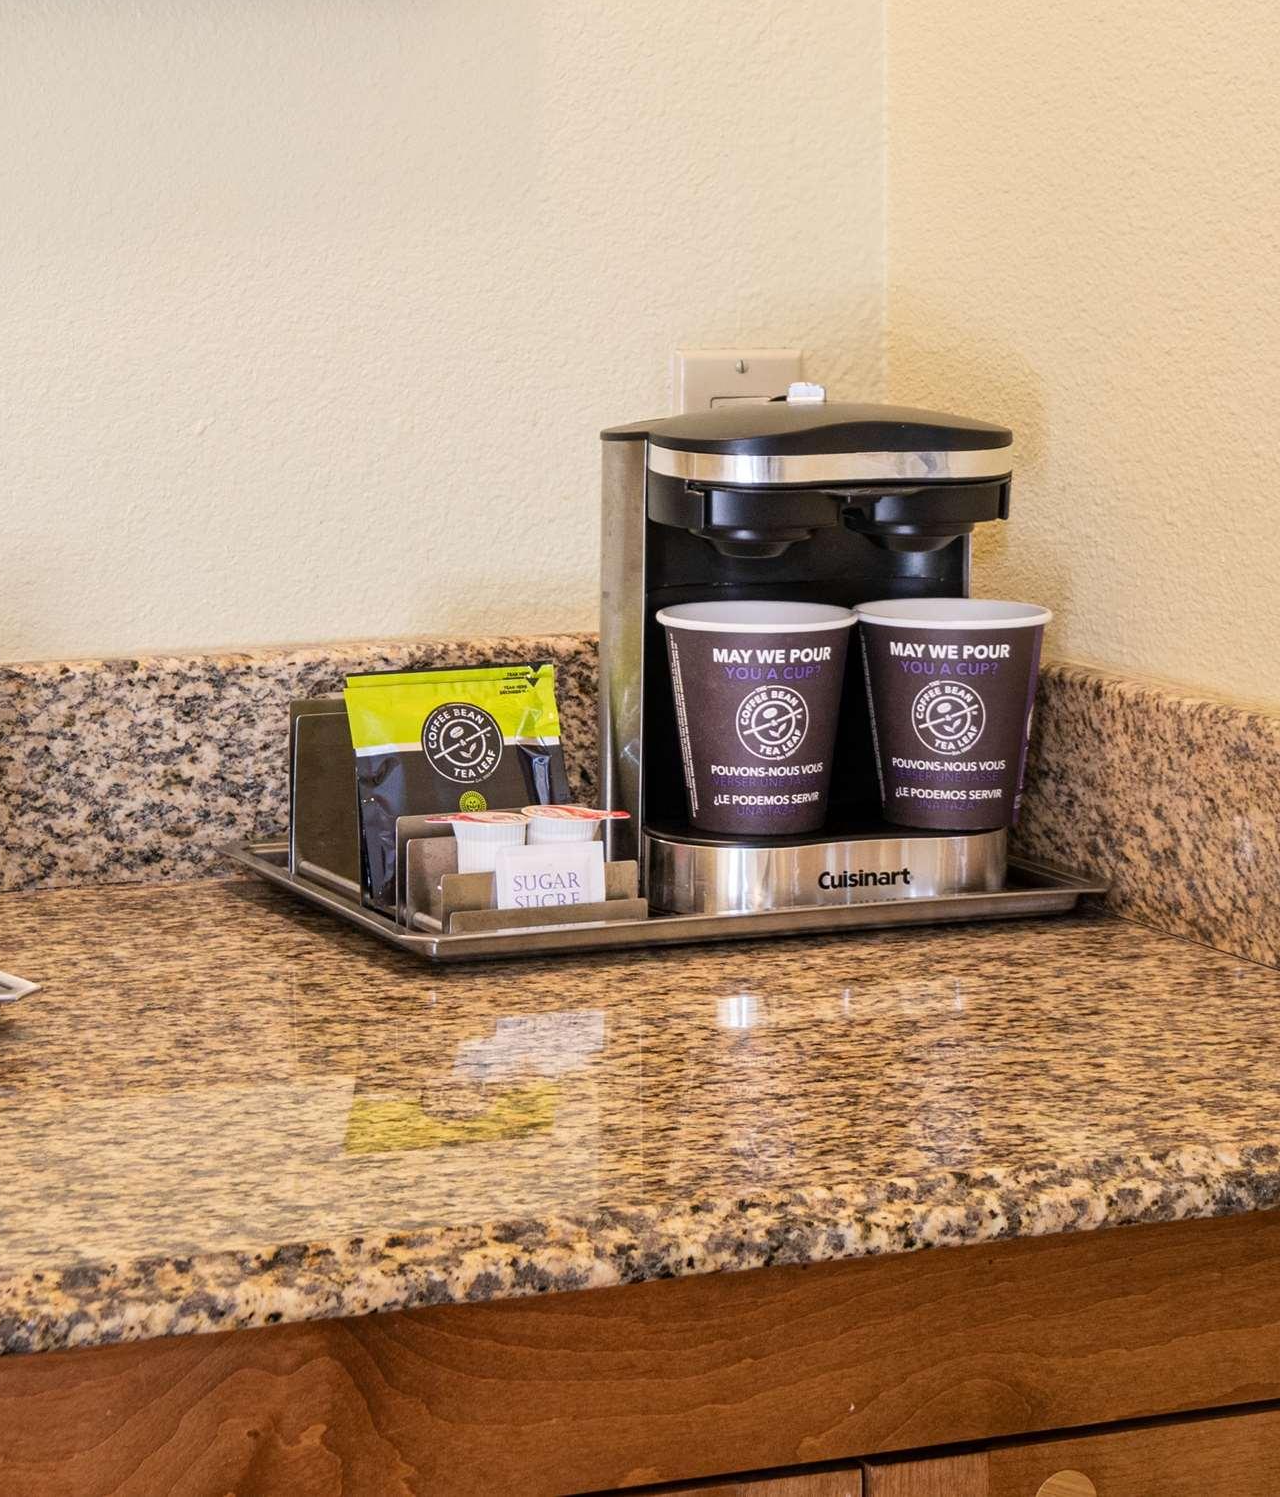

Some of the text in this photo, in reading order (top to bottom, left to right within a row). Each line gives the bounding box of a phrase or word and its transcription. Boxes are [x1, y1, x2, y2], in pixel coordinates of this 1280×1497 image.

[712, 646, 832, 664] MAY WE POUR
[889, 641, 1011, 659] MAY WE POUR
[724, 665, 821, 680] YOU A CUP?
[901, 660, 999, 676] YOU A CUP?
[740, 690, 800, 726] COFFEE BEAN
[916, 685, 974, 719] COFFEE BEAN
[428, 708, 485, 749] COFFEE BEAN
[934, 738, 956, 750] TEA
[956, 724, 978, 748] LEAF
[759, 744, 781, 756] TEA
[781, 728, 802, 752] LEAF
[453, 767, 477, 779] TEA
[476, 749, 497, 774] LEAF
[711, 762, 824, 777] POUVONS-NOUS VOUS
[892, 756, 1007, 772] POUVONS-NOUS VOUS
[713, 791, 820, 806] ¿LE PODEMOS SERVIR
[910, 788, 967, 800] PODEMOS
[968, 788, 1002, 800] SERVIR
[513, 871, 581, 892] SUGAR
[817, 868, 911, 890] Cuisinart
